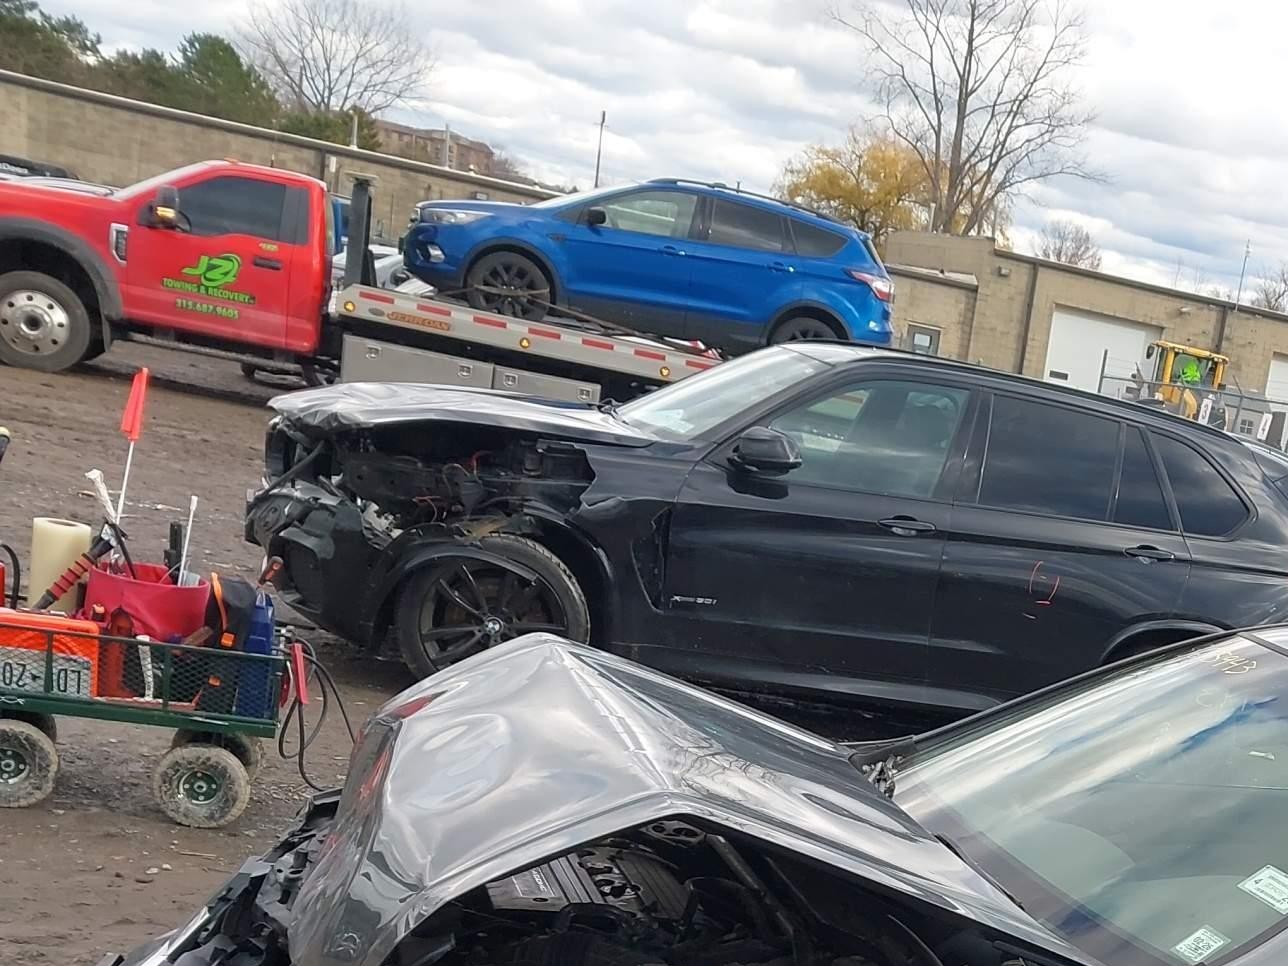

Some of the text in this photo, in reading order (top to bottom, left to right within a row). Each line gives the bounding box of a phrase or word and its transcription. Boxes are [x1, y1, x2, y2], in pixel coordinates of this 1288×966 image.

[162, 278, 199, 293] TOWING
[207, 287, 250, 304] RECOVERY
[1260, 414, 1270, 435] 4
